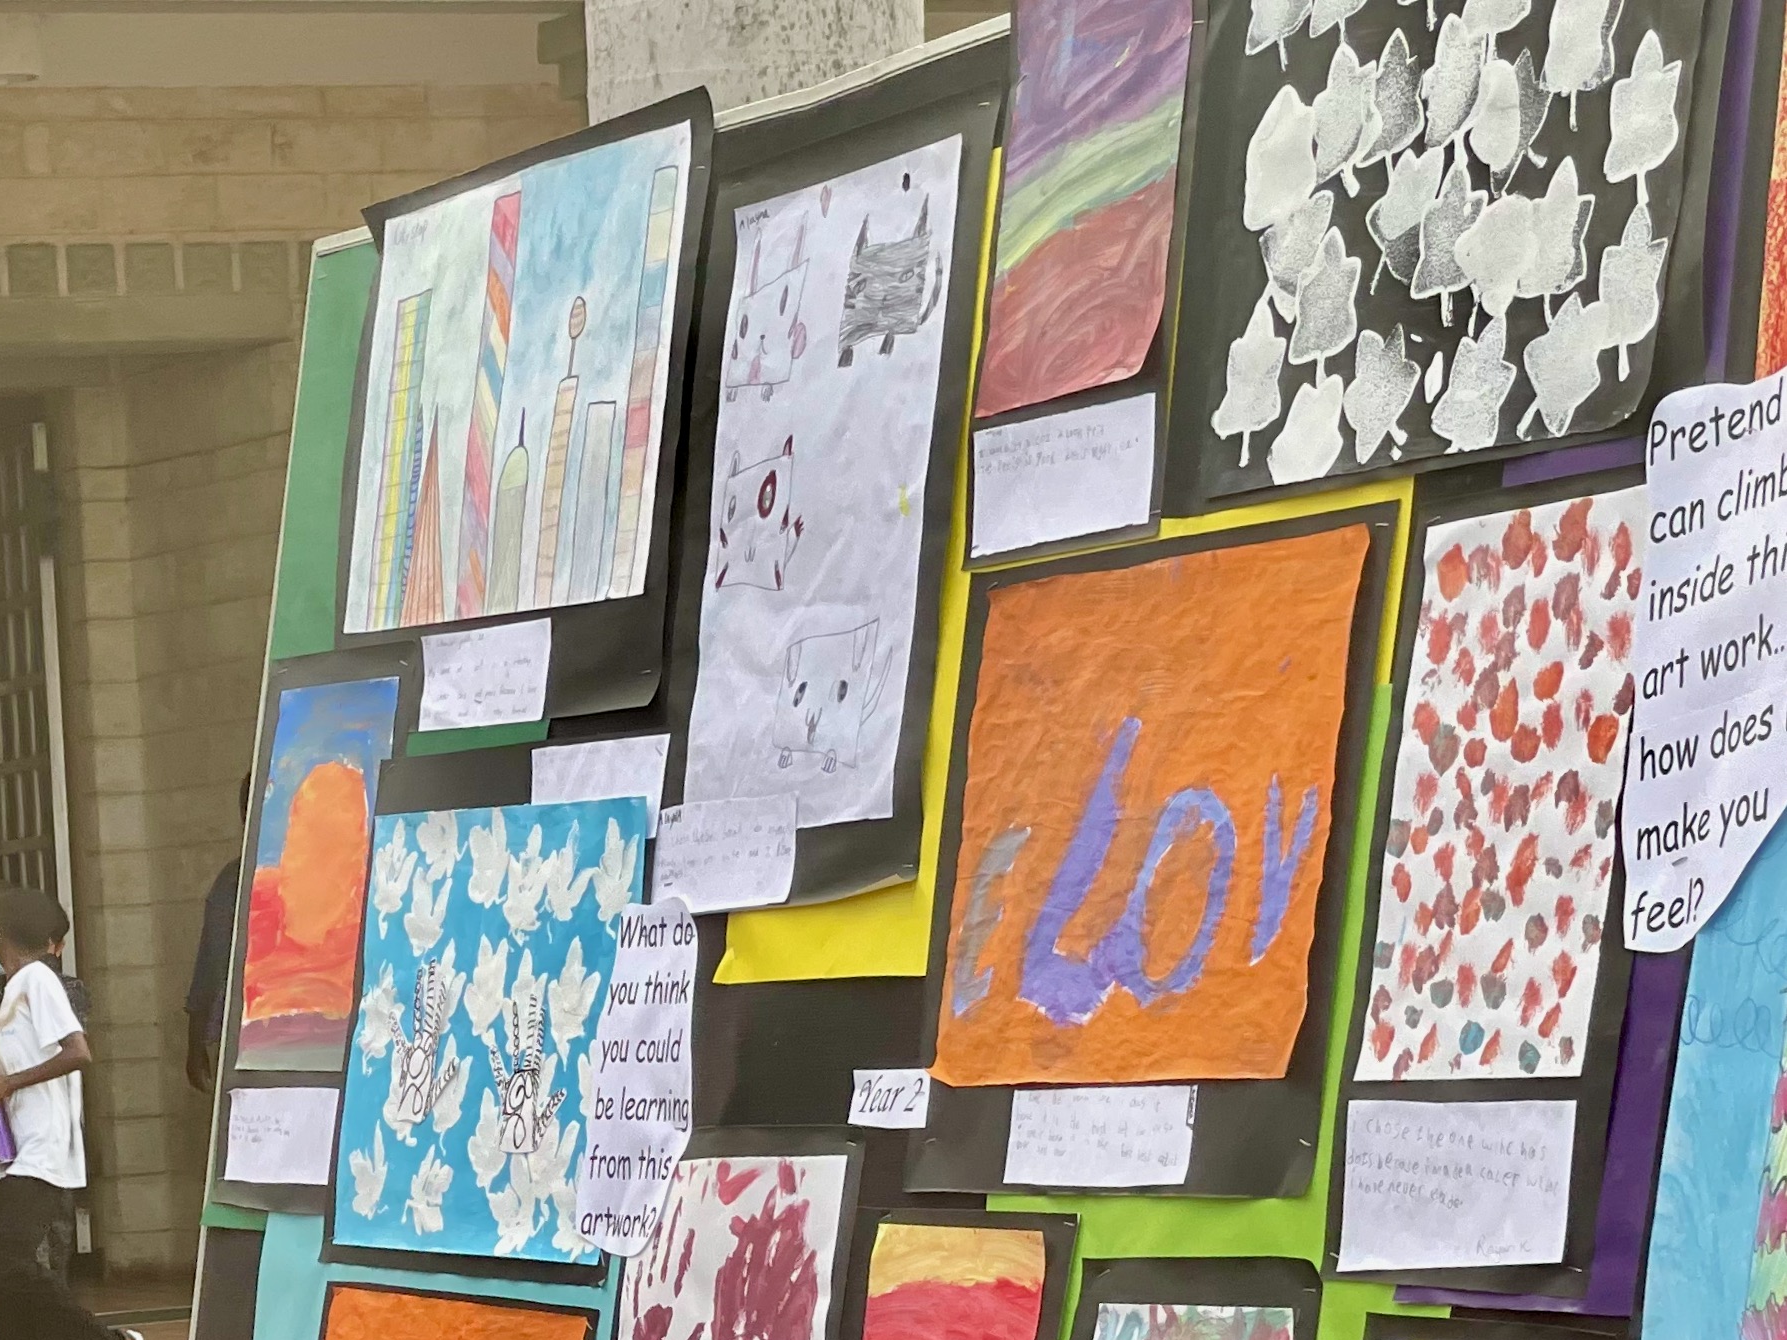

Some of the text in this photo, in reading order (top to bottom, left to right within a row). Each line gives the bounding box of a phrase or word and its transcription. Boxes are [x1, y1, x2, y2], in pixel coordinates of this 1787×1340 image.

[1648, 375, 1783, 467] Pretend
[1650, 497, 1704, 544] can
[1648, 554, 1734, 622] inside
[1642, 649, 1689, 699] art
[1639, 704, 1773, 782] how does
[1636, 787, 1768, 861] make you
[620, 911, 694, 948] What do
[1630, 878, 1705, 940] feel?
[609, 969, 690, 1015] you think
[600, 1029, 683, 1073] you could
[594, 1087, 690, 1132] be learning
[858, 1074, 925, 1112] Year 2
[589, 1144, 673, 1180] from this
[580, 1205, 657, 1238] artwork?
